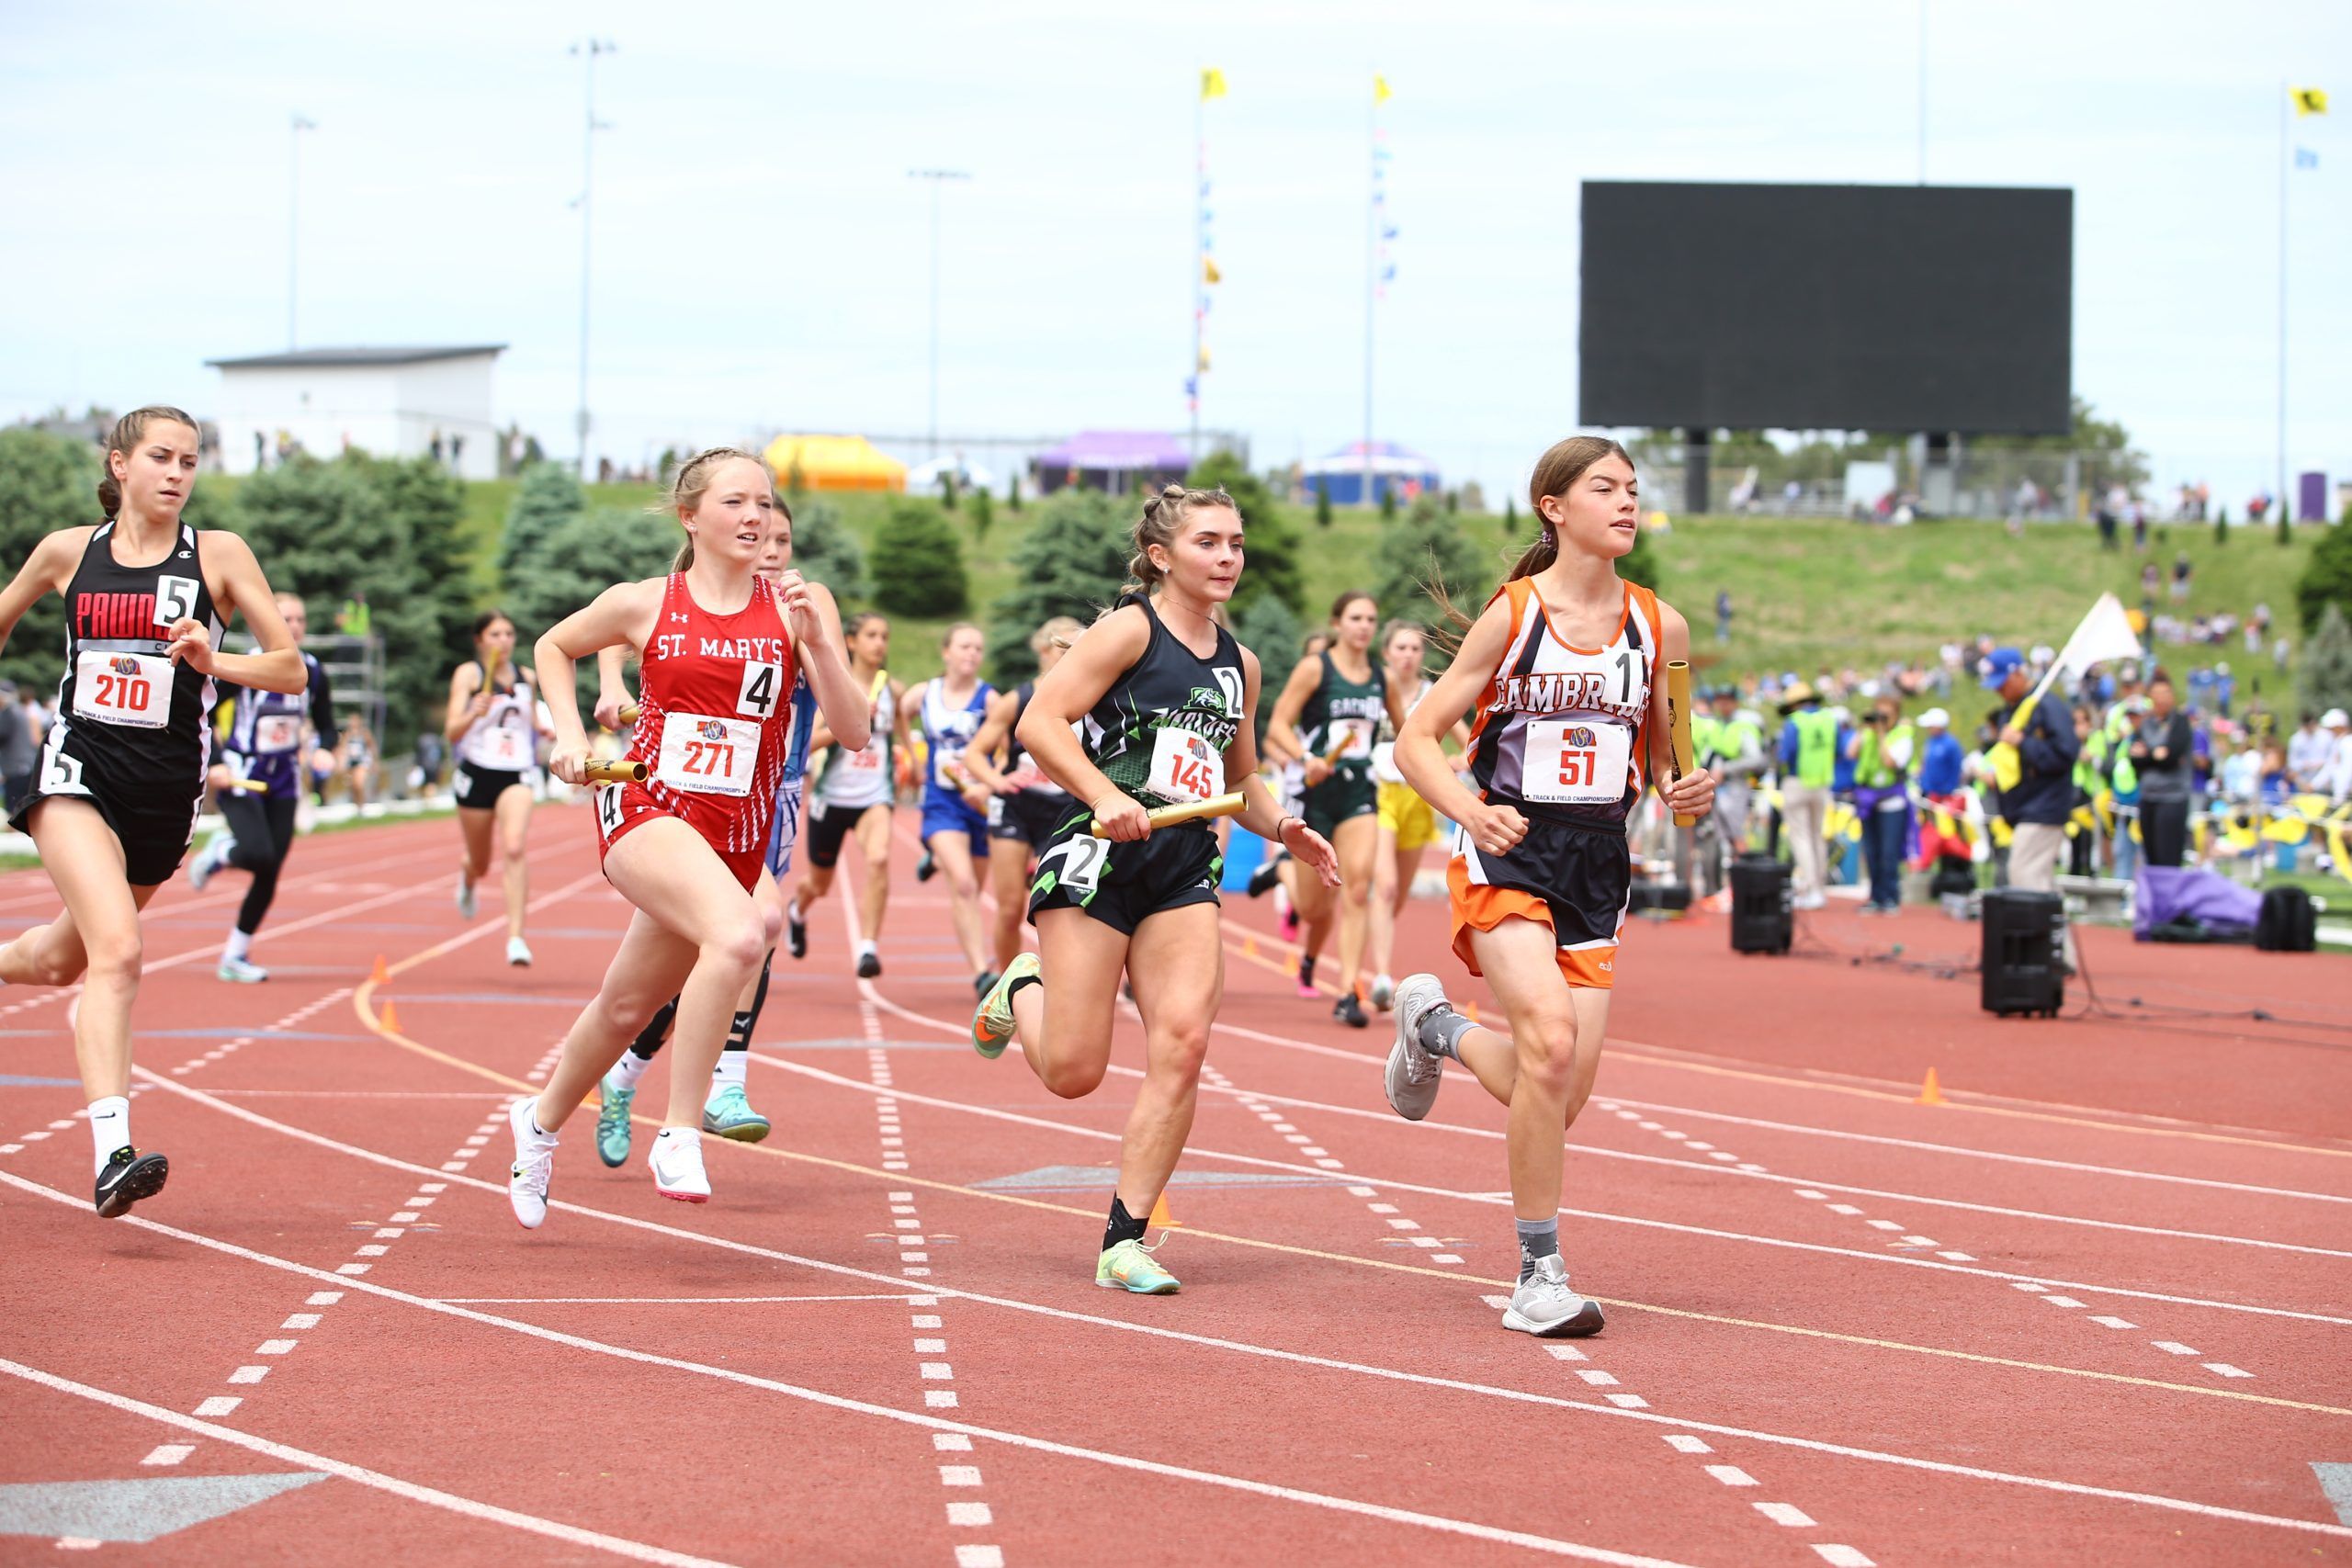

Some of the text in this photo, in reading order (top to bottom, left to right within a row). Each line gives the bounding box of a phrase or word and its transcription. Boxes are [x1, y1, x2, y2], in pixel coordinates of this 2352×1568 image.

[164, 580, 189, 625] 5
[657, 634, 783, 665] ST. MARY'S
[95, 674, 151, 711] 210
[745, 667, 774, 714] 4
[1221, 670, 1241, 715] 2
[1615, 652, 1632, 703] 1
[682, 740, 734, 777] 271
[1170, 753, 1213, 799] 145
[1558, 750, 1596, 786] 51
[603, 785, 616, 826] 4
[1067, 839, 1098, 886] 2
